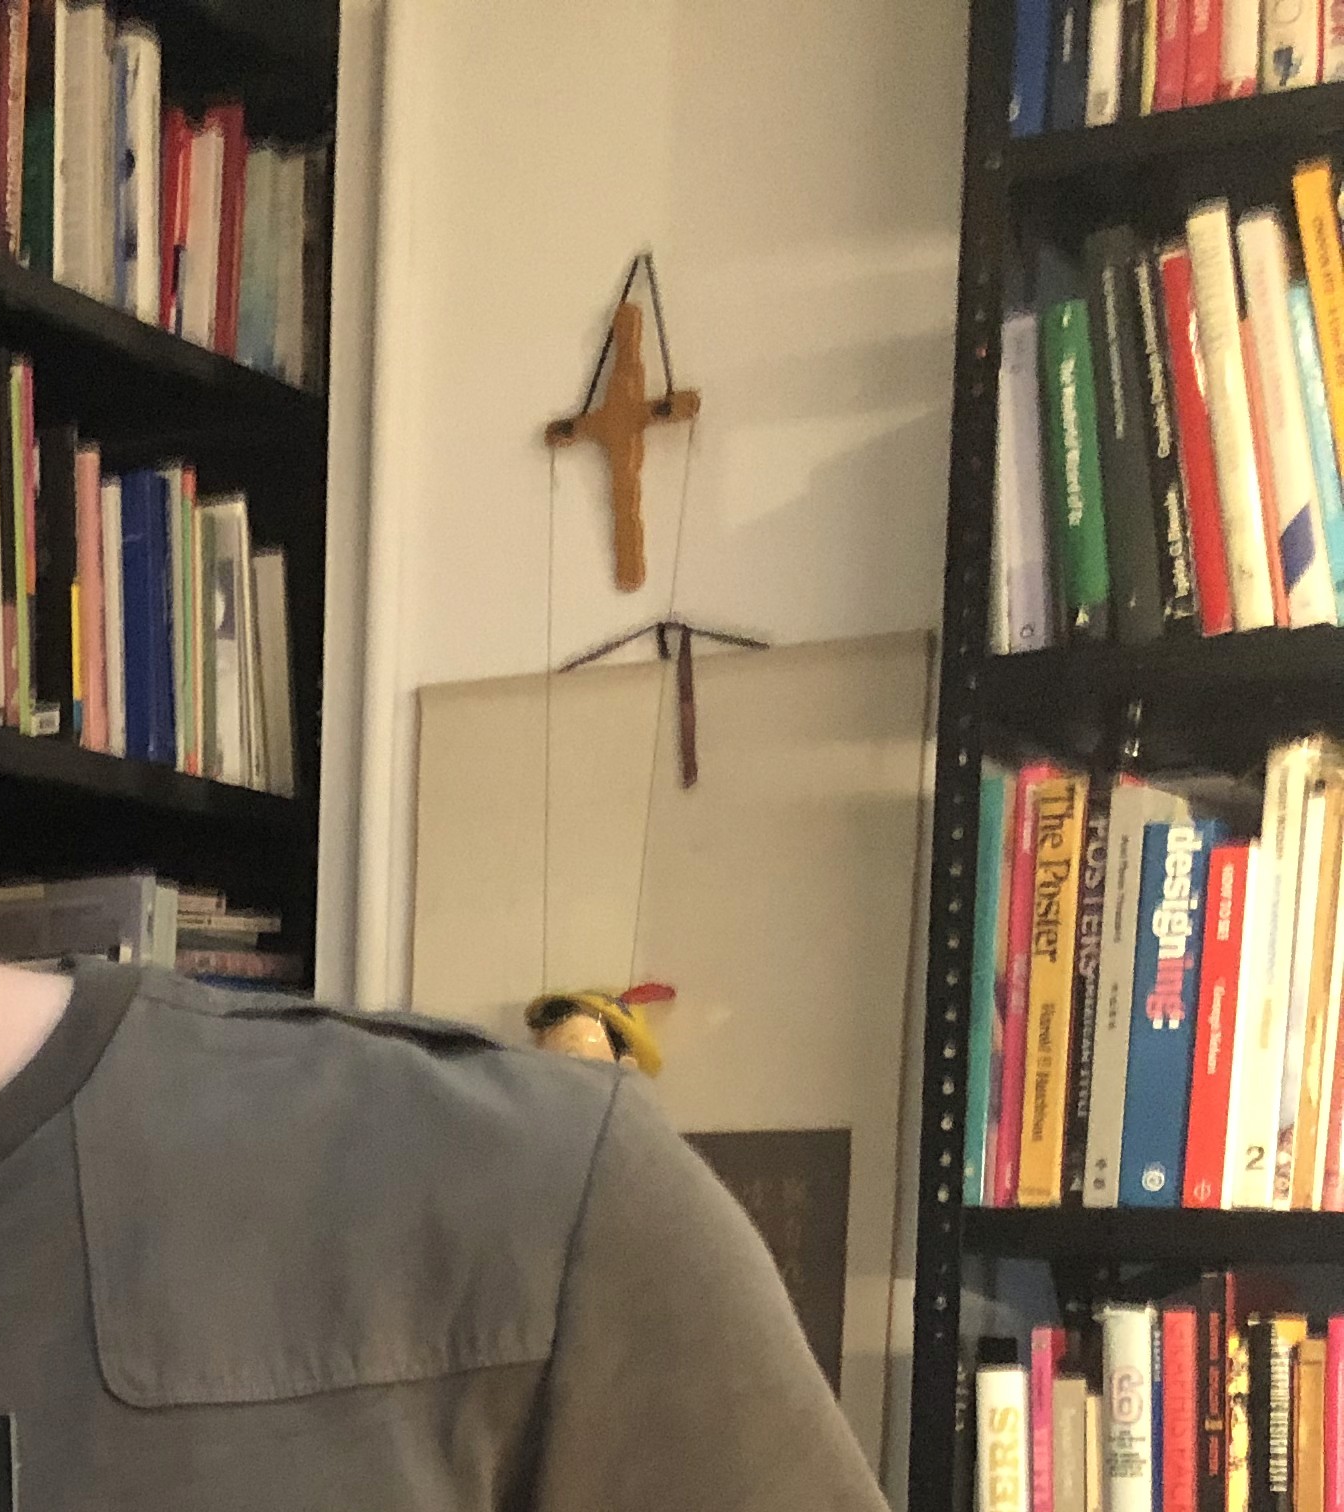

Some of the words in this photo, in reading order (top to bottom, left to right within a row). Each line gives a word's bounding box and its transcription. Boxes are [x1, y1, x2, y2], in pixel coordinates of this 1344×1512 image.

[1042, 786, 1076, 849] The
[1034, 858, 1070, 964] Poster
[1245, 1146, 1266, 1172] 2
